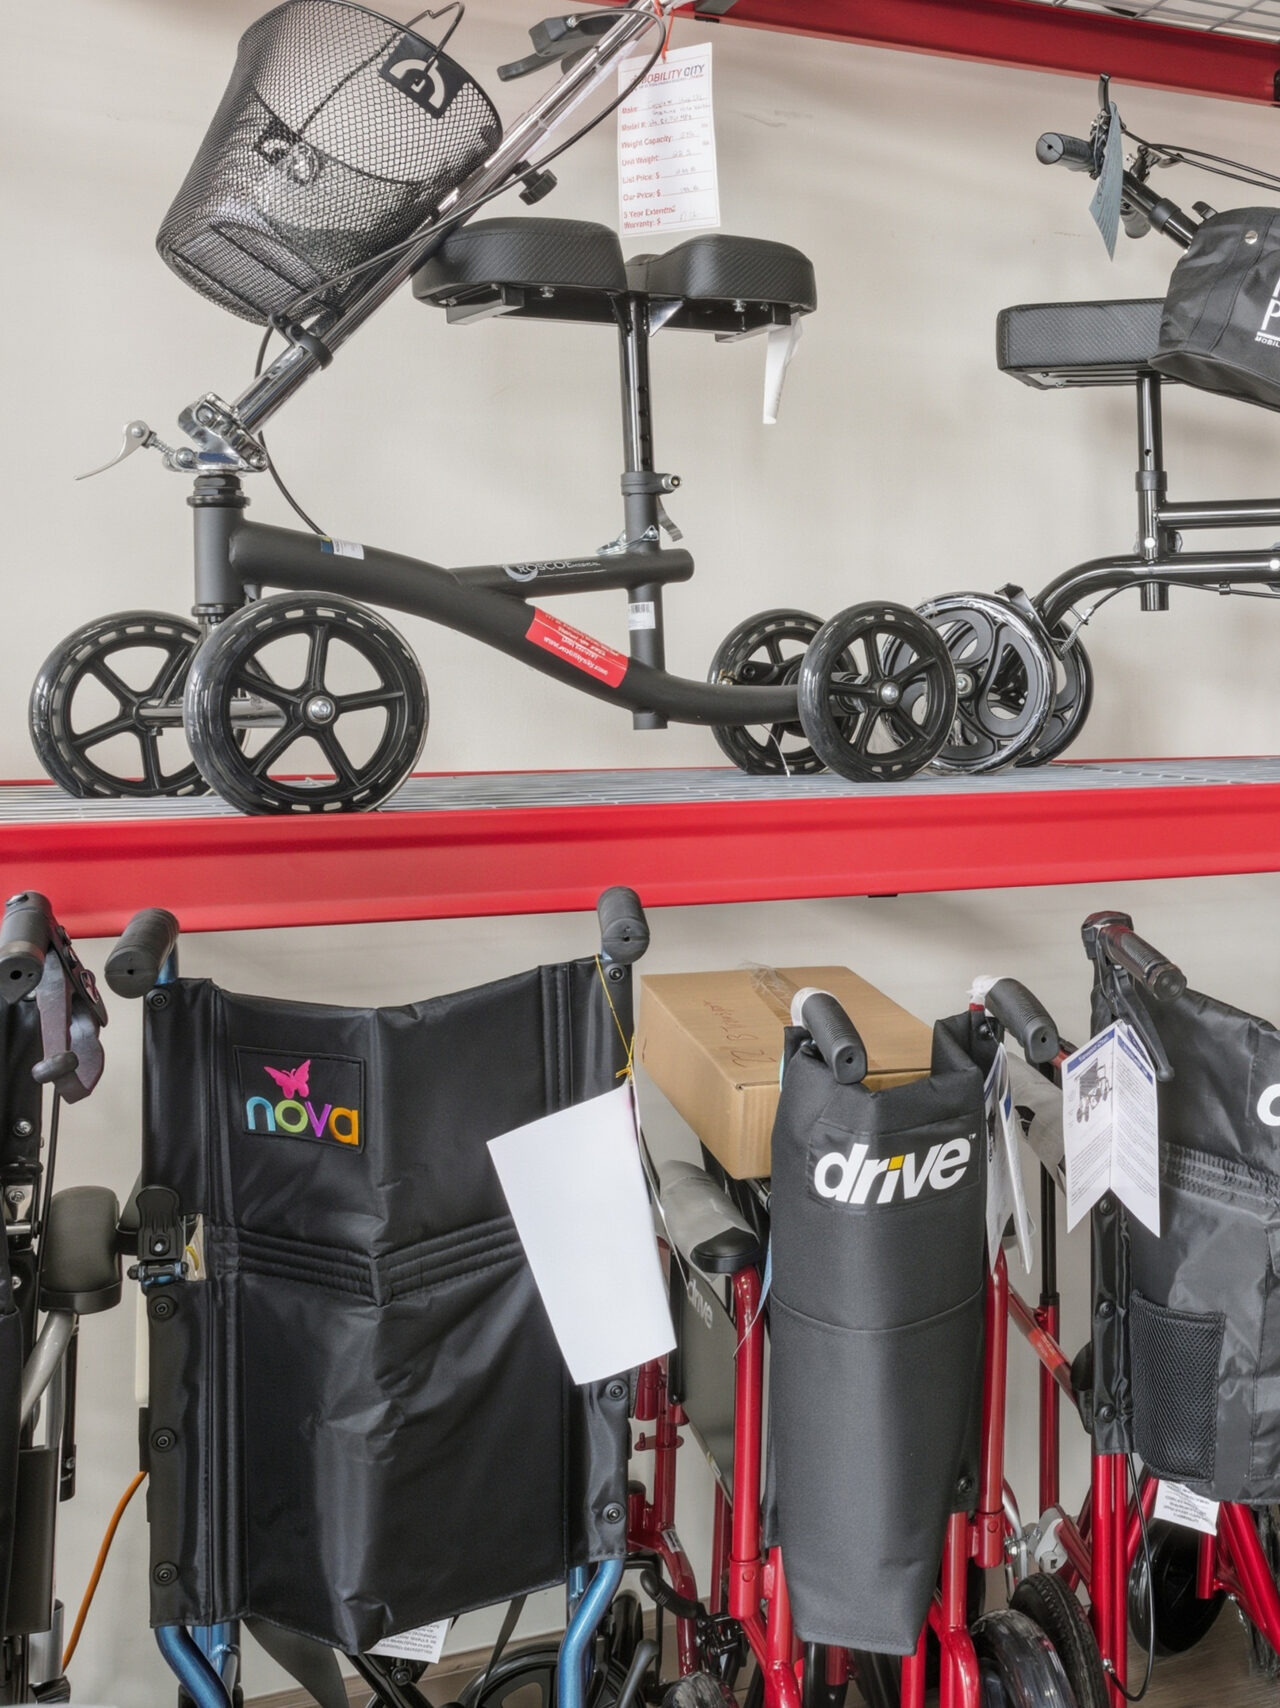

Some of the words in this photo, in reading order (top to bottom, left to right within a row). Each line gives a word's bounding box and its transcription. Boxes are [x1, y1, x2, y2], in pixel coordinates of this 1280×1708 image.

[684, 64, 705, 77] CITY
[622, 176, 635, 184] List
[516, 560, 572, 574] ROSCOE
[246, 1096, 359, 1146] nova
[814, 1137, 972, 1204] drive
